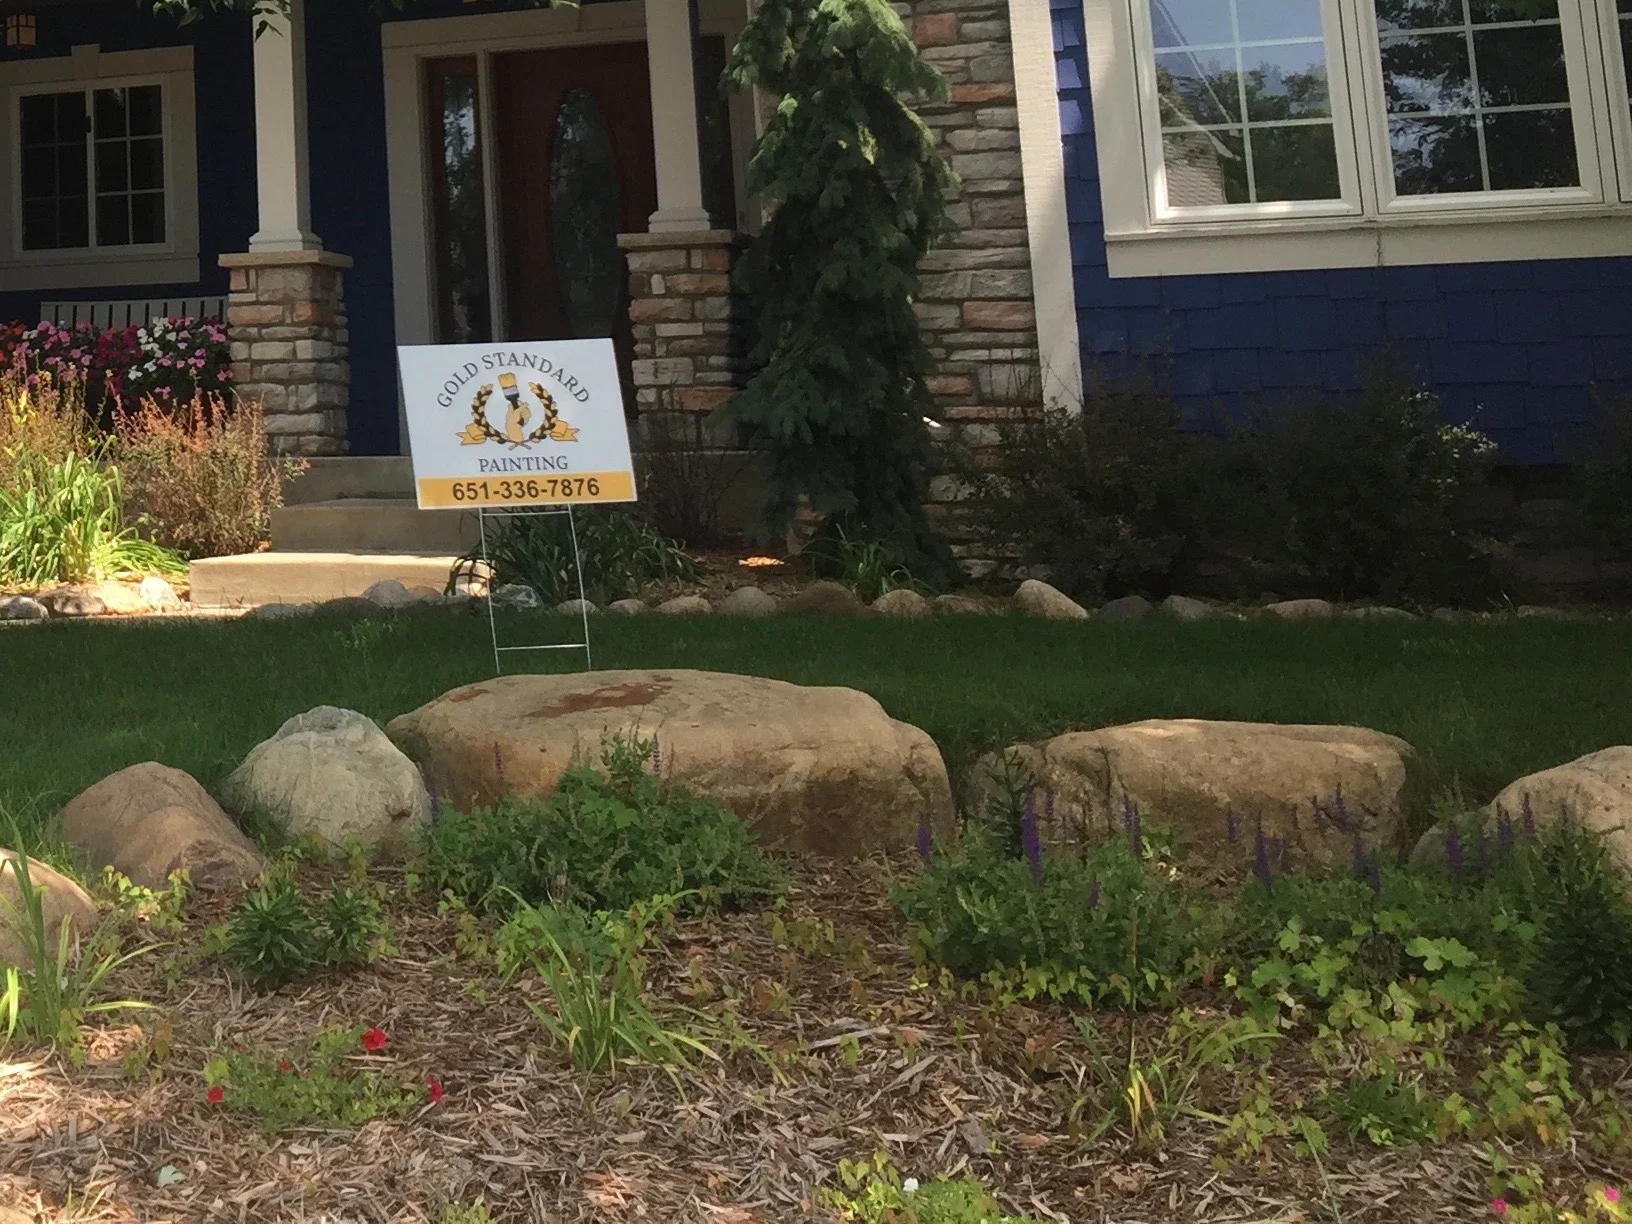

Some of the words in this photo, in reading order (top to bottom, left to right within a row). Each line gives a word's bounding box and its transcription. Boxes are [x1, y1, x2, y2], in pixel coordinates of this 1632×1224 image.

[436, 361, 479, 408] GOLD
[481, 351, 590, 404] STANDARD
[478, 455, 569, 473] PAINTING
[451, 477, 600, 501] 651-336-7876
